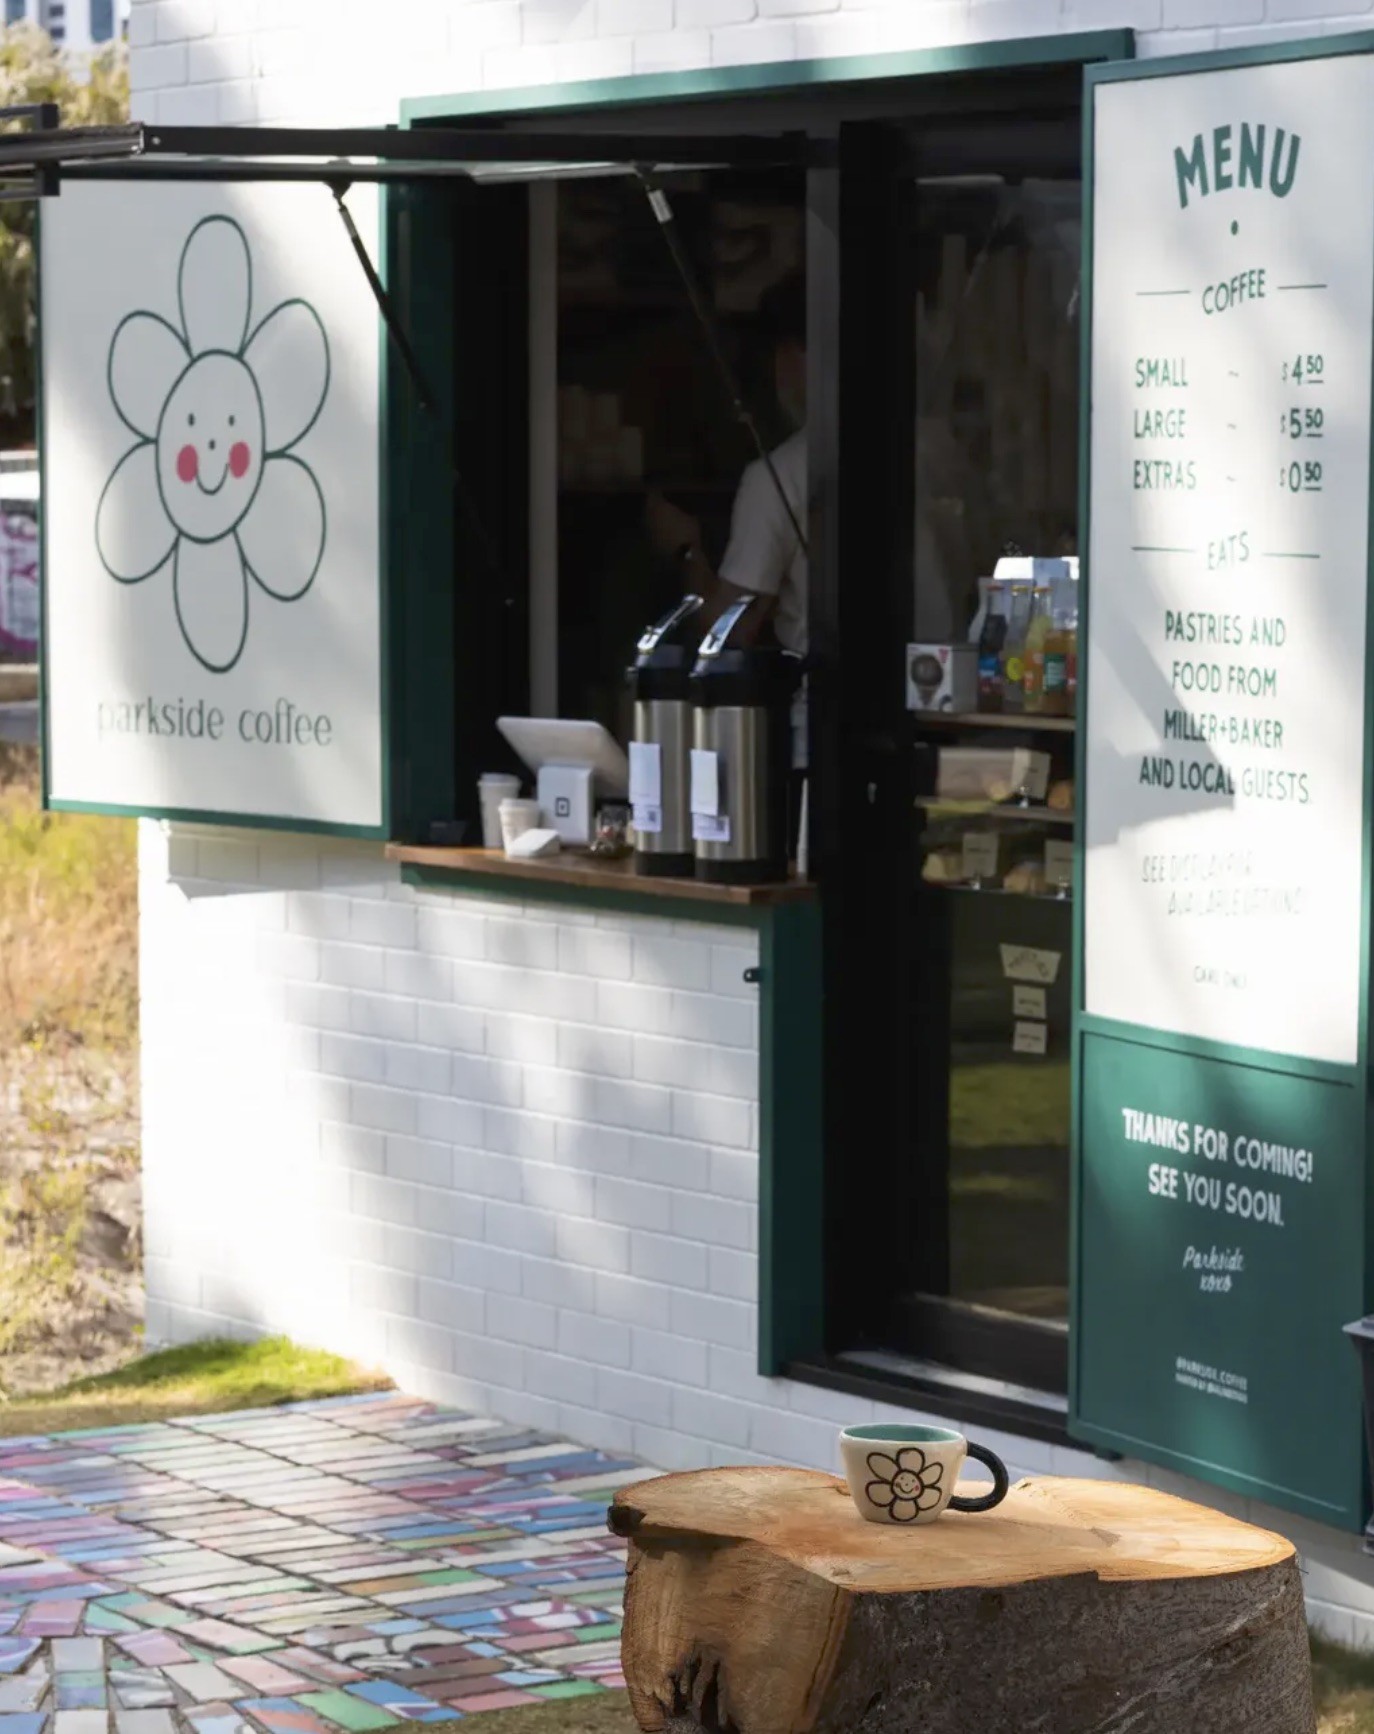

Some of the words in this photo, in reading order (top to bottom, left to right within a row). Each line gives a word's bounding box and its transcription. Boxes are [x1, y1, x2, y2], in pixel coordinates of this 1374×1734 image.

[1174, 122, 1301, 209] MENU
[1202, 269, 1265, 315] COFFEE
[1135, 357, 1188, 387] SMALL
[1134, 409, 1185, 439] LARGE
[1134, 460, 1196, 489] EXTRAS
[1207, 531, 1249, 570] EATS
[1165, 610, 1242, 645] PASTRIES
[1250, 616, 1286, 647] AND
[1172, 661, 1221, 693] FOOD
[1228, 665, 1277, 697] FROM
[98, 696, 224, 742] parkside
[238, 697, 332, 746] coffee
[1164, 708, 1283, 748] MILLER+BAKER
[1139, 756, 1174, 789] AND
[1180, 760, 1235, 795] LOCAL
[1241, 768, 1309, 803] GUESTS
[1121, 1107, 1190, 1154] THANKS
[1193, 1124, 1229, 1161] FOR
[1234, 1135, 1313, 1183] COMING!
[1148, 1163, 1178, 1199] SEE
[1183, 1171, 1220, 1210] YOU
[1225, 1182, 1284, 1226] SOON.
[1182, 1245, 1244, 1271] Parkside
